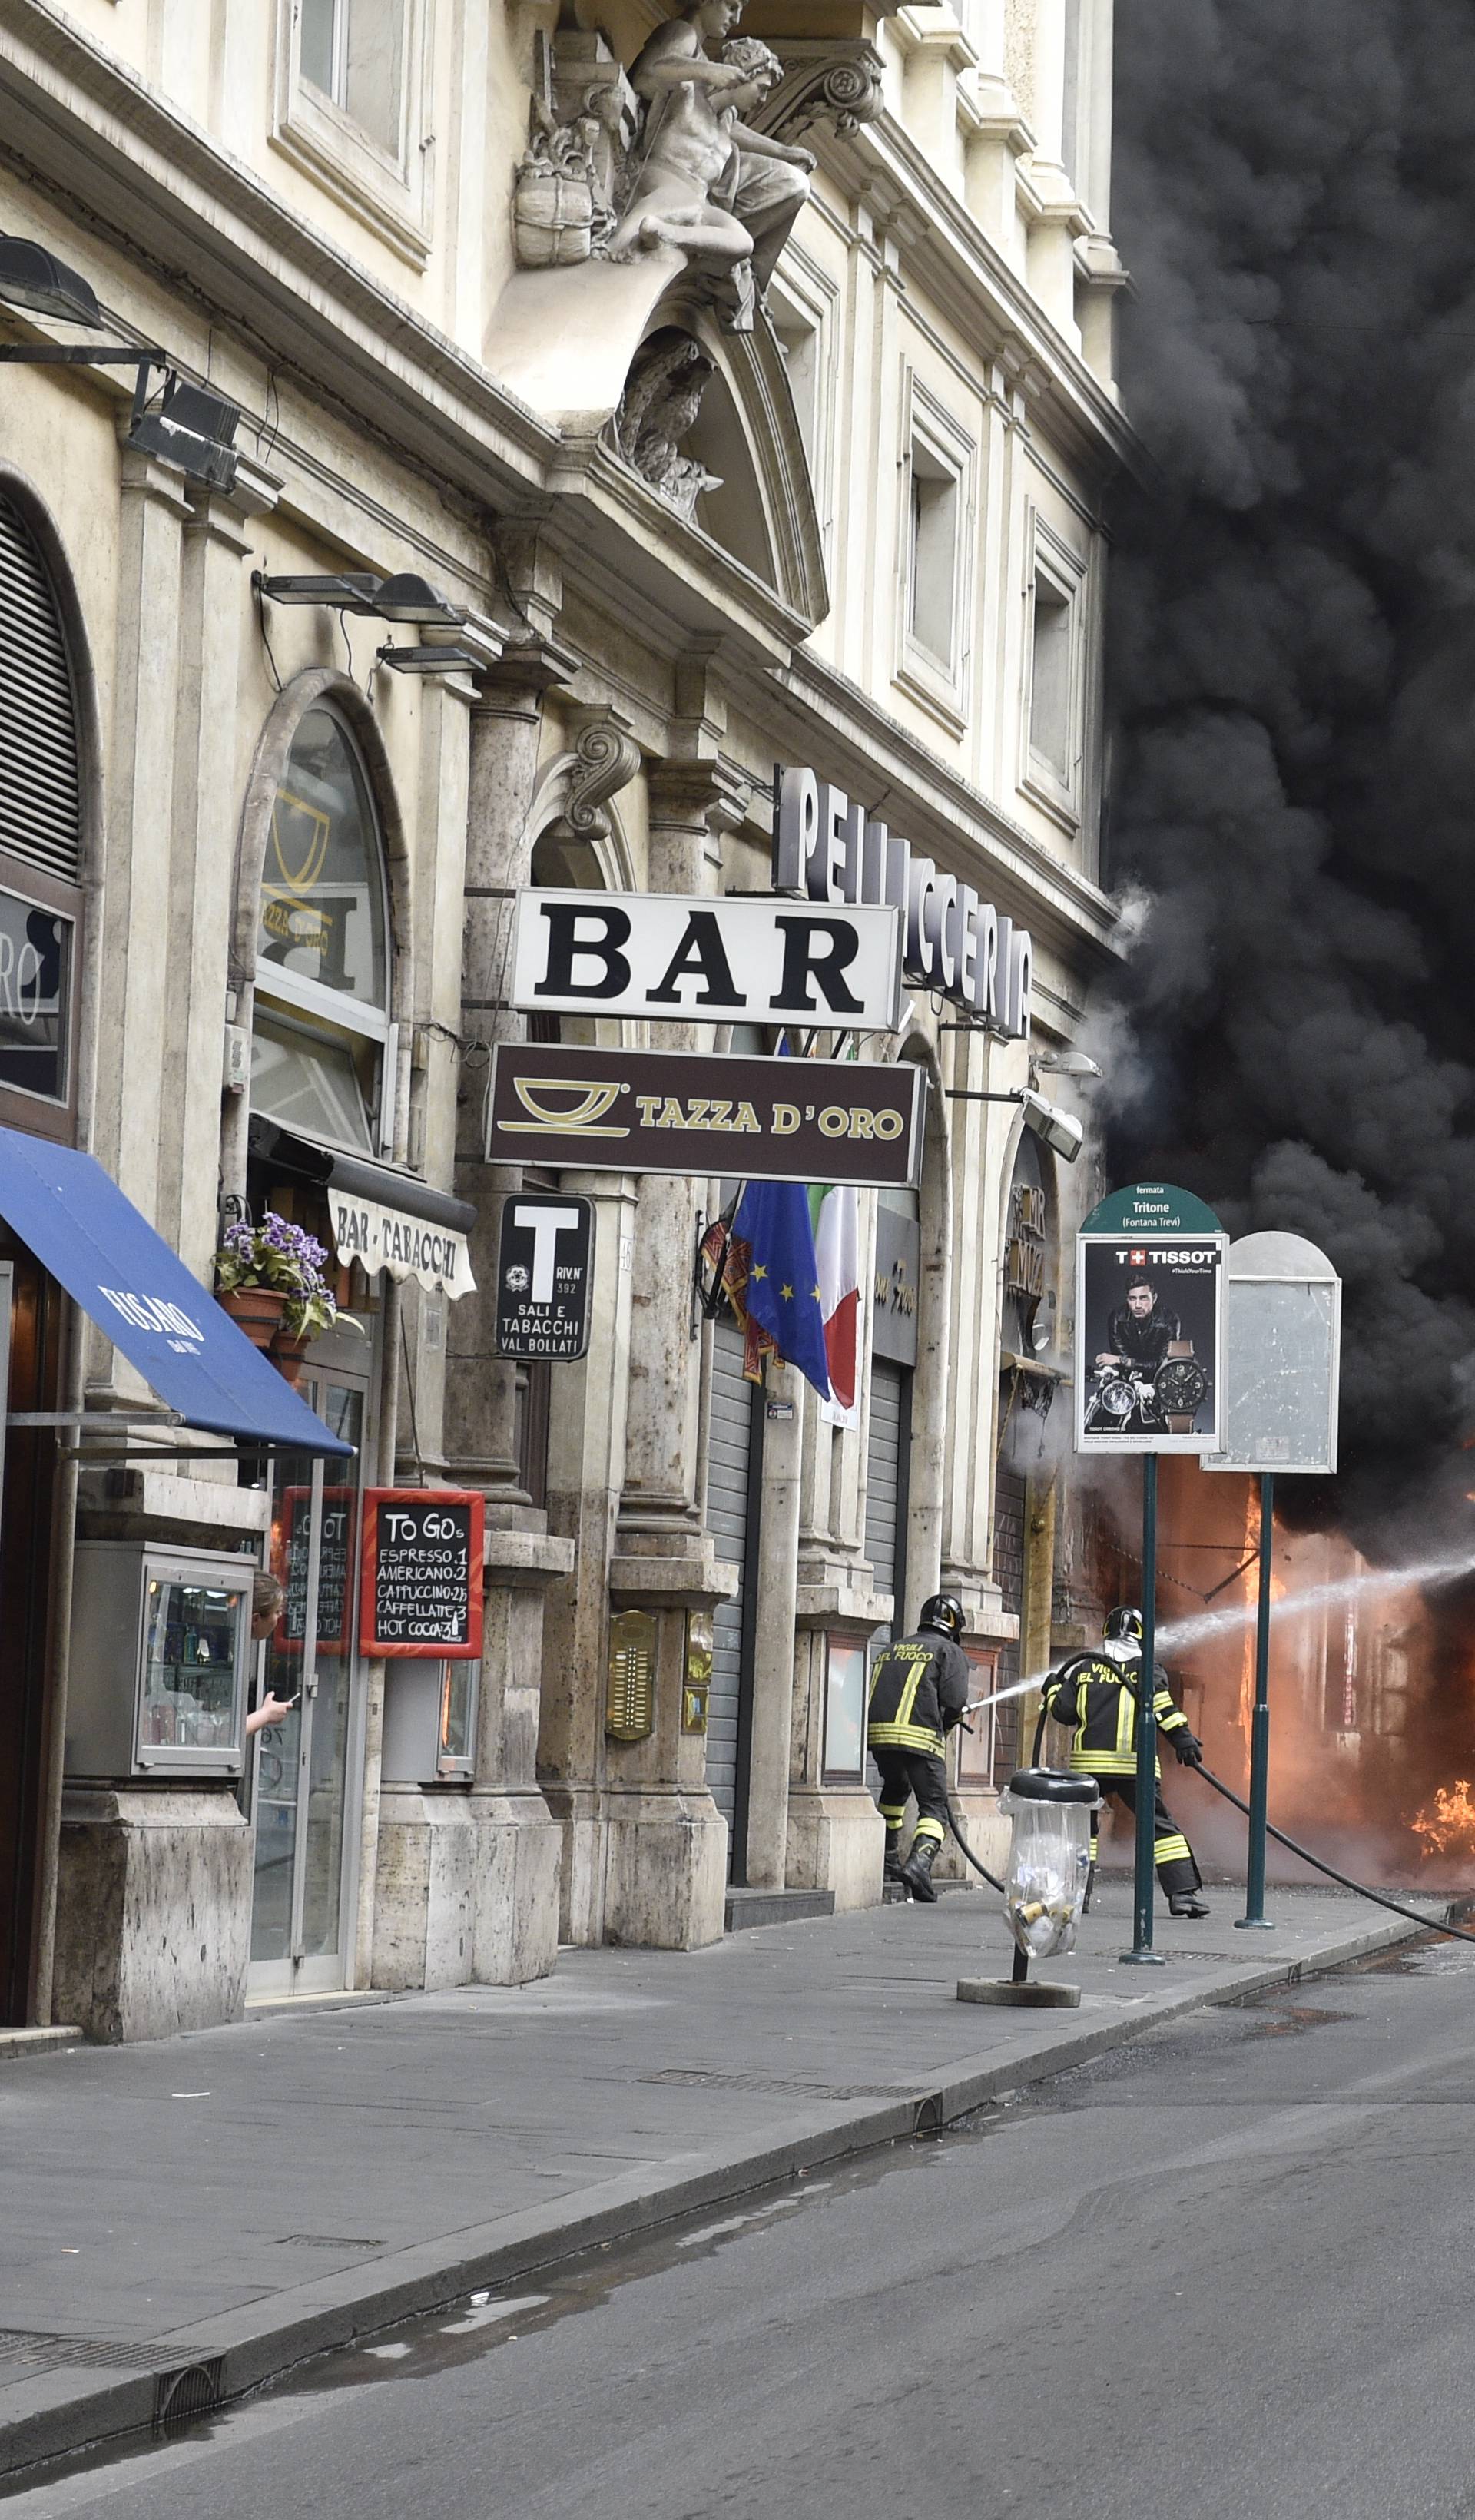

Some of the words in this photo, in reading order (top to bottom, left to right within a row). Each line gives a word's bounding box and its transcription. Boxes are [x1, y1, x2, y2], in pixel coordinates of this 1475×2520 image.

[534, 901, 865, 1014] BAR
[636, 1096, 761, 1133] TAZZA
[771, 1103, 903, 1141] D'ORO
[1133, 1202, 1169, 1213] Tritone
[1122, 1216, 1157, 1228] (Fontana
[1159, 1216, 1181, 1228] Trevi)
[338, 1206, 369, 1253] BAR
[382, 1219, 456, 1280] TABACCHI
[514, 1205, 579, 1303] T
[1149, 1252, 1216, 1264] TISSOT
[97, 1285, 204, 1341] FUSARO
[518, 1305, 549, 1316] SALI
[558, 1306, 565, 1317] E
[502, 1318, 578, 1335] TABACCHI
[502, 1337, 525, 1351] VAL.
[529, 1338, 576, 1353] BOLLATI
[378, 1619, 406, 1636] HOT
[894, 1651, 933, 1661] FUOCO
